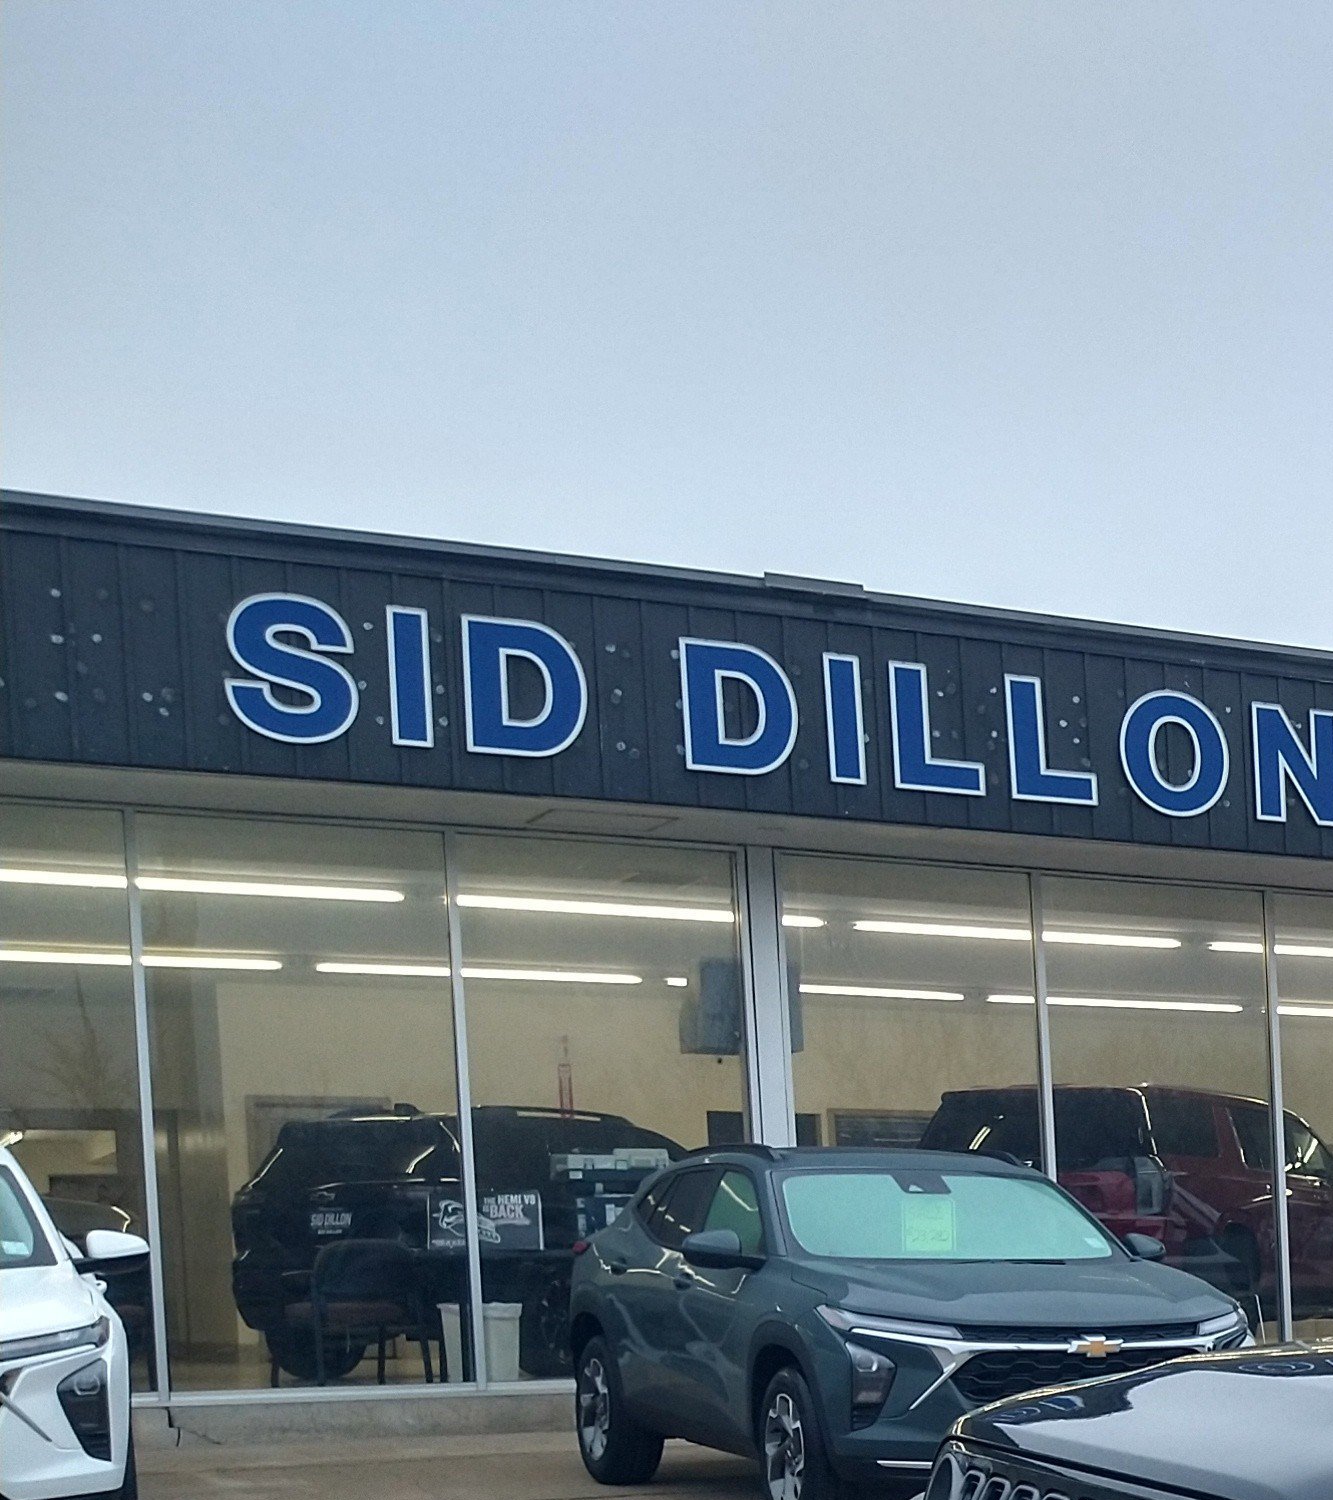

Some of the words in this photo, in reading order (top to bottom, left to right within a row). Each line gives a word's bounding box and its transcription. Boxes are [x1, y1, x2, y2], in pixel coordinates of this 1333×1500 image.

[224, 592, 588, 758] SID
[483, 1196, 496, 1205] THE
[497, 1194, 523, 1205] HEMI
[489, 1204, 524, 1219] BACK
[310, 1213, 324, 1226] SID
[324, 1212, 352, 1226] DILLON
